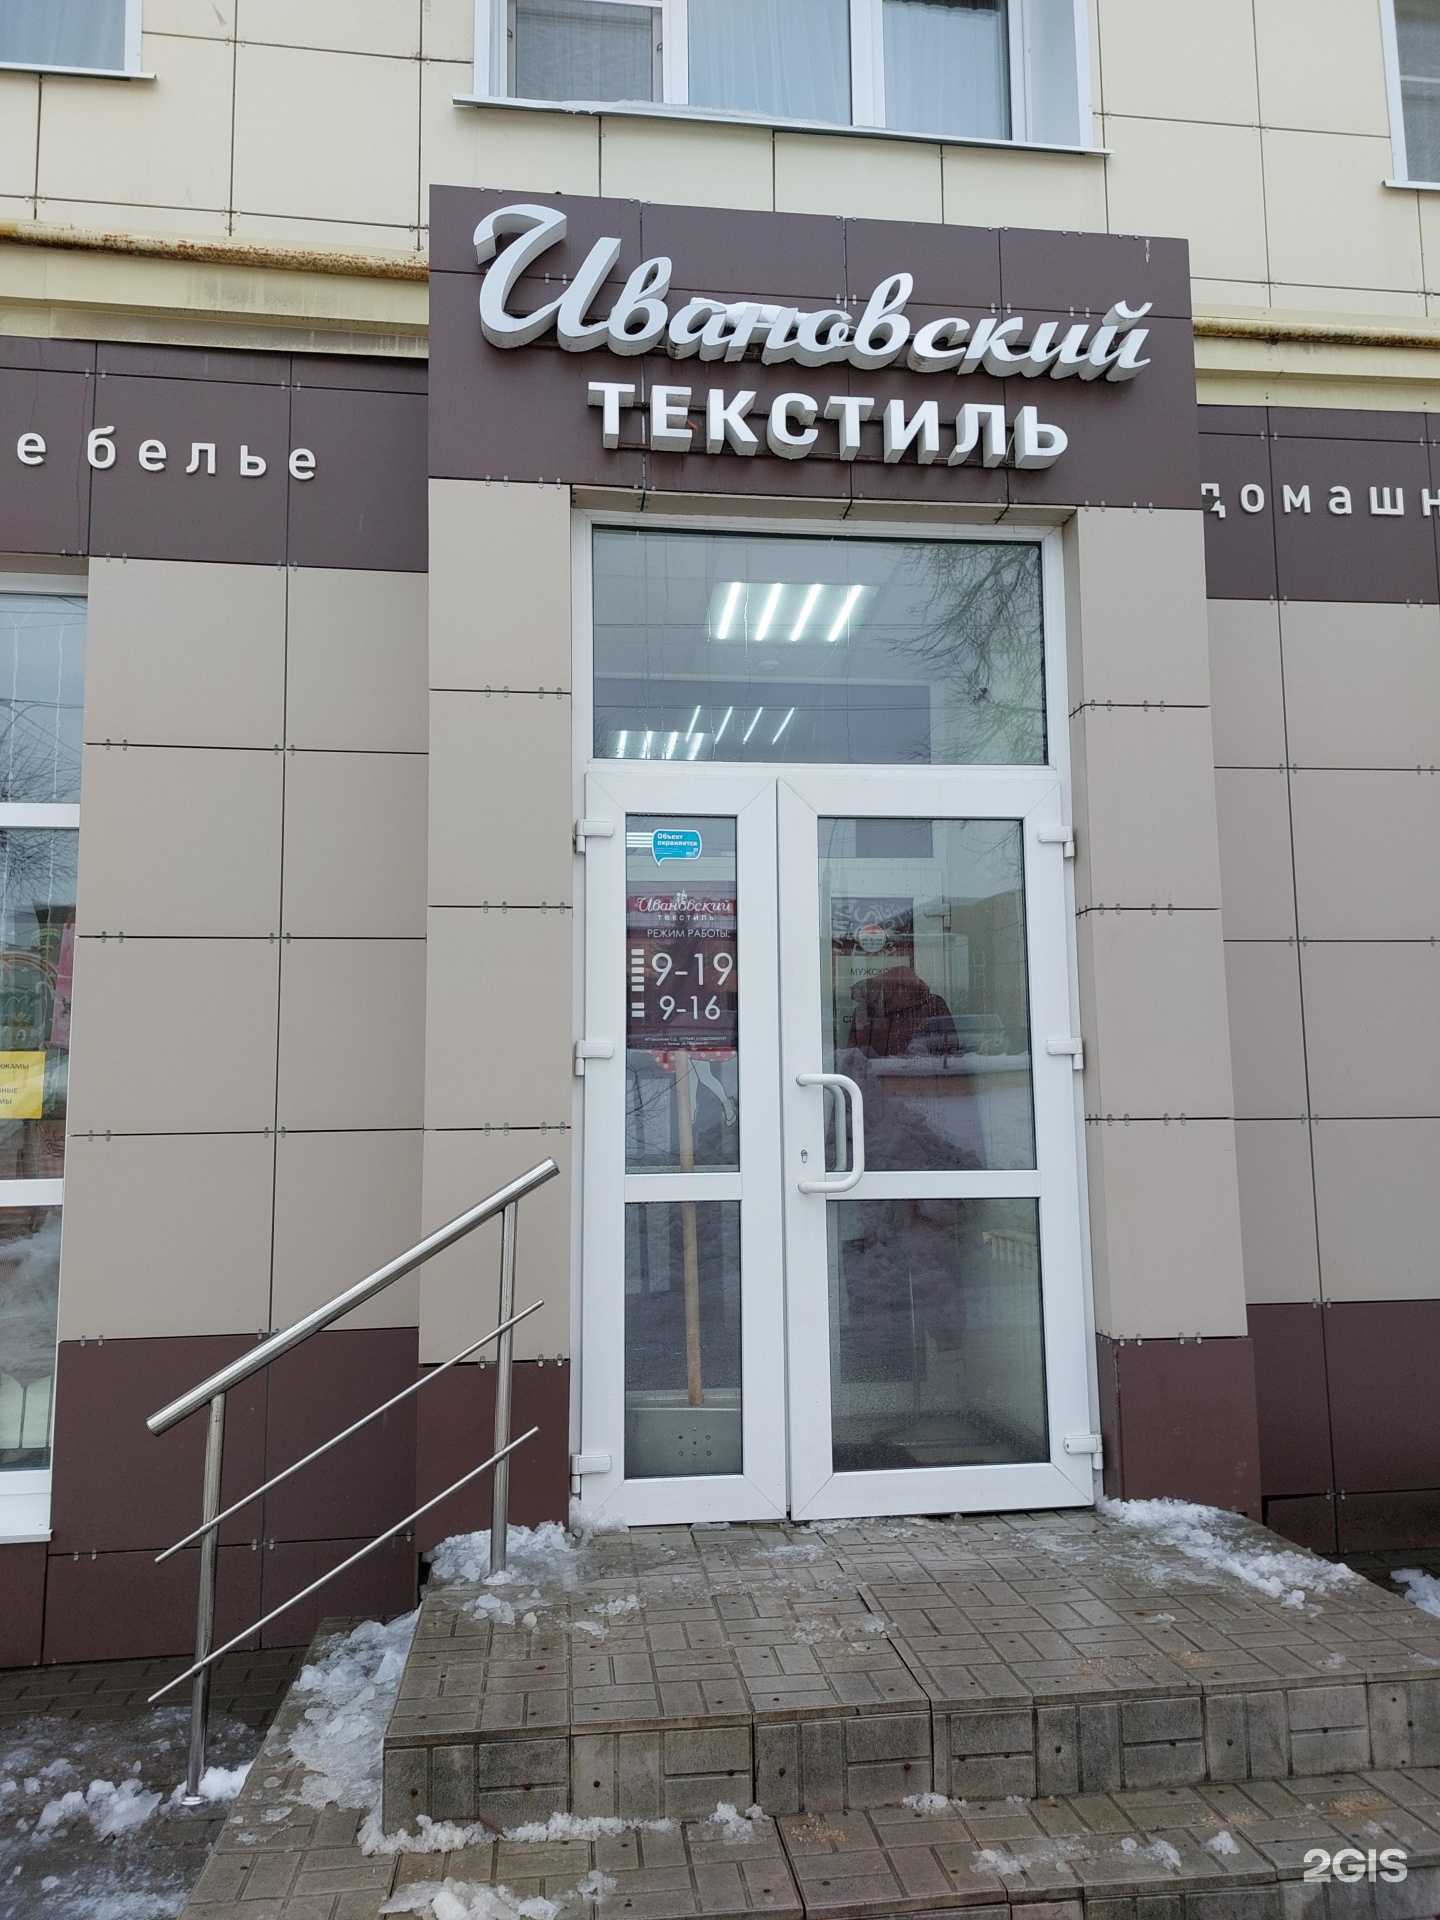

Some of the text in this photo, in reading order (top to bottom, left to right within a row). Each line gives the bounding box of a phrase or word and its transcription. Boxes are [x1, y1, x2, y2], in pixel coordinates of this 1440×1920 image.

[473, 203, 1153, 382] Ивановский
[588, 381, 1069, 469] ТЕКСТИЛЬ
[16, 425, 317, 481] е белье
[636, 896, 732, 914] Ивановский
[647, 928, 686, 938] РЕЖИМ
[651, 952, 733, 986] 9-19
[659, 995, 721, 1020] 9-16
